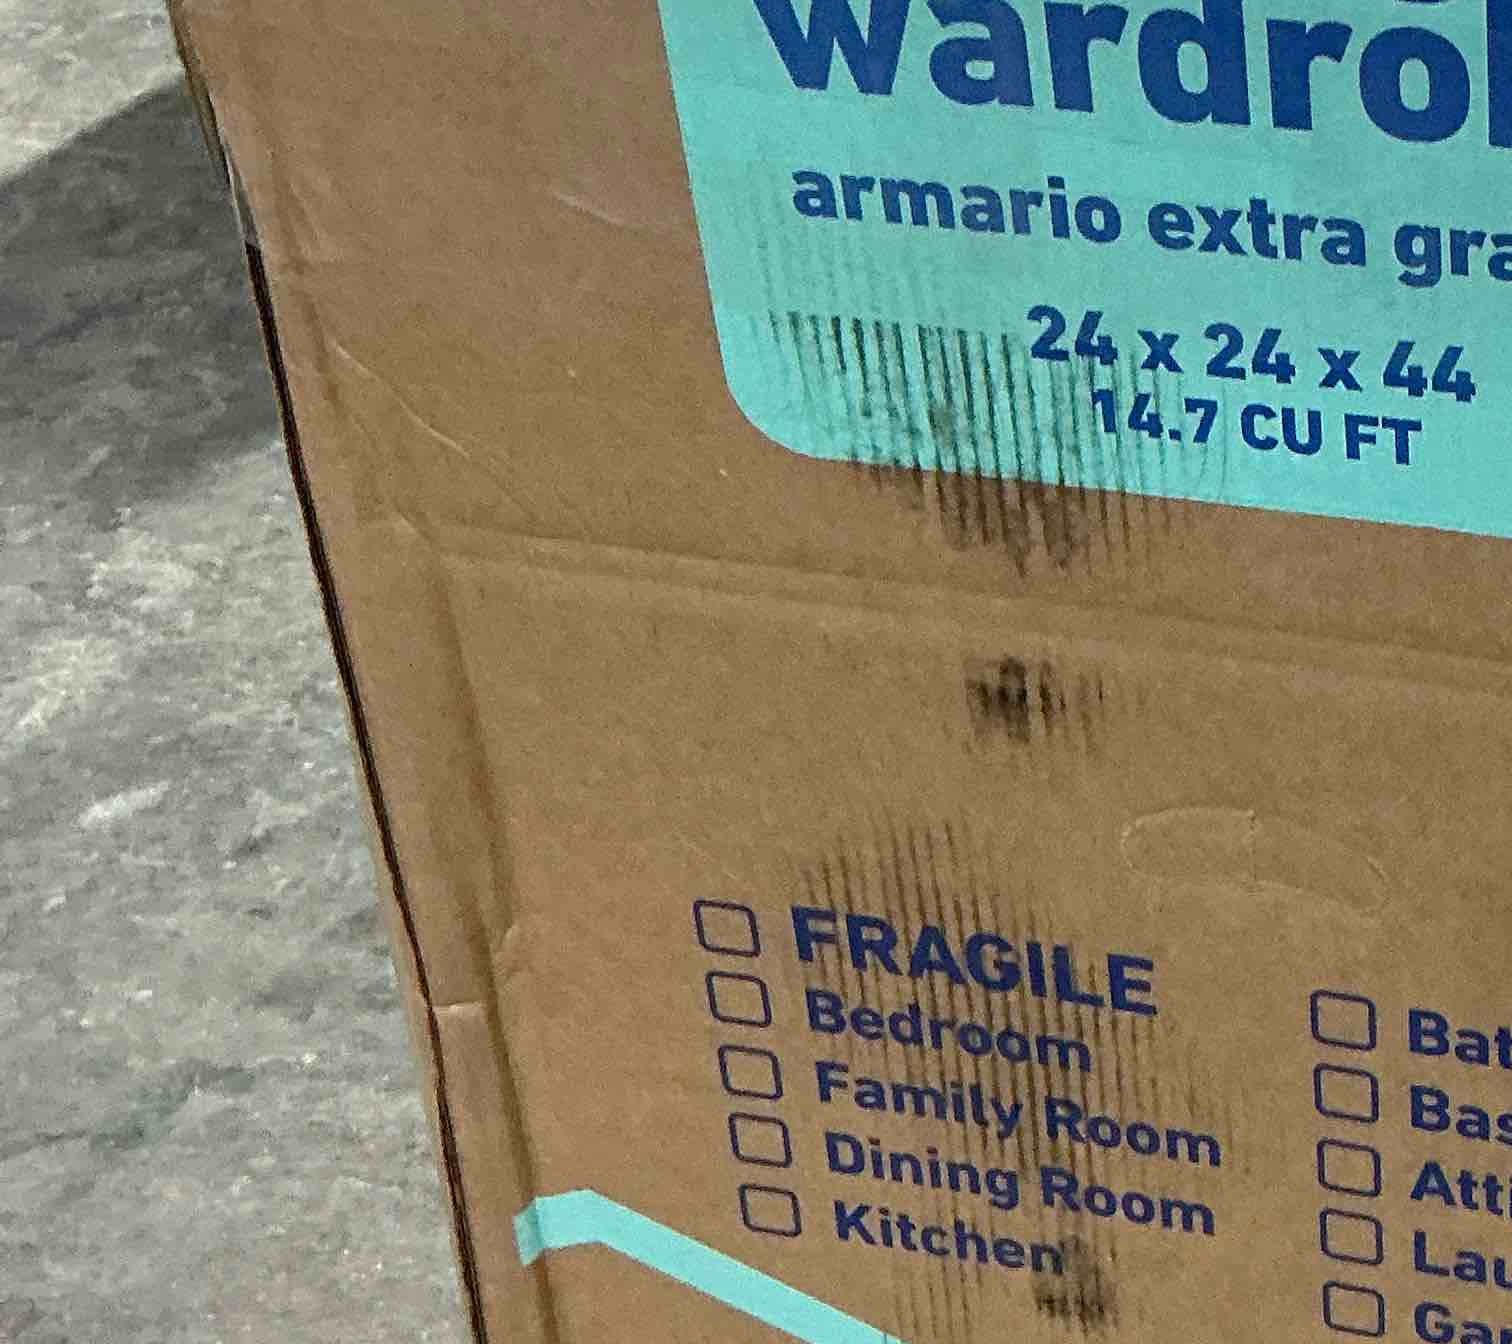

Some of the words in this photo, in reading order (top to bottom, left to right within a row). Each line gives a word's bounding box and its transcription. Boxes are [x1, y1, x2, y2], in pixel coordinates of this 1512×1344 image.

[792, 168, 1122, 244] armario
[1147, 197, 1367, 267] extra
[1027, 305, 1118, 365] 24
[1138, 329, 1183, 373] x
[1204, 322, 1296, 384] 24
[1318, 347, 1363, 392] x
[1383, 341, 1477, 402] 44
[1091, 389, 1218, 443] 14.7
[1240, 403, 1323, 456] CU
[1343, 413, 1422, 465] FT
[791, 905, 1158, 1017] FRAGILE
[805, 987, 1092, 1073] Bedroom
[815, 1060, 1023, 1138] Family
[1044, 1095, 1222, 1168] Room
[825, 1131, 1020, 1211] Dining
[1040, 1165, 1216, 1236] Room
[833, 1199, 1065, 1275] Kitchen
